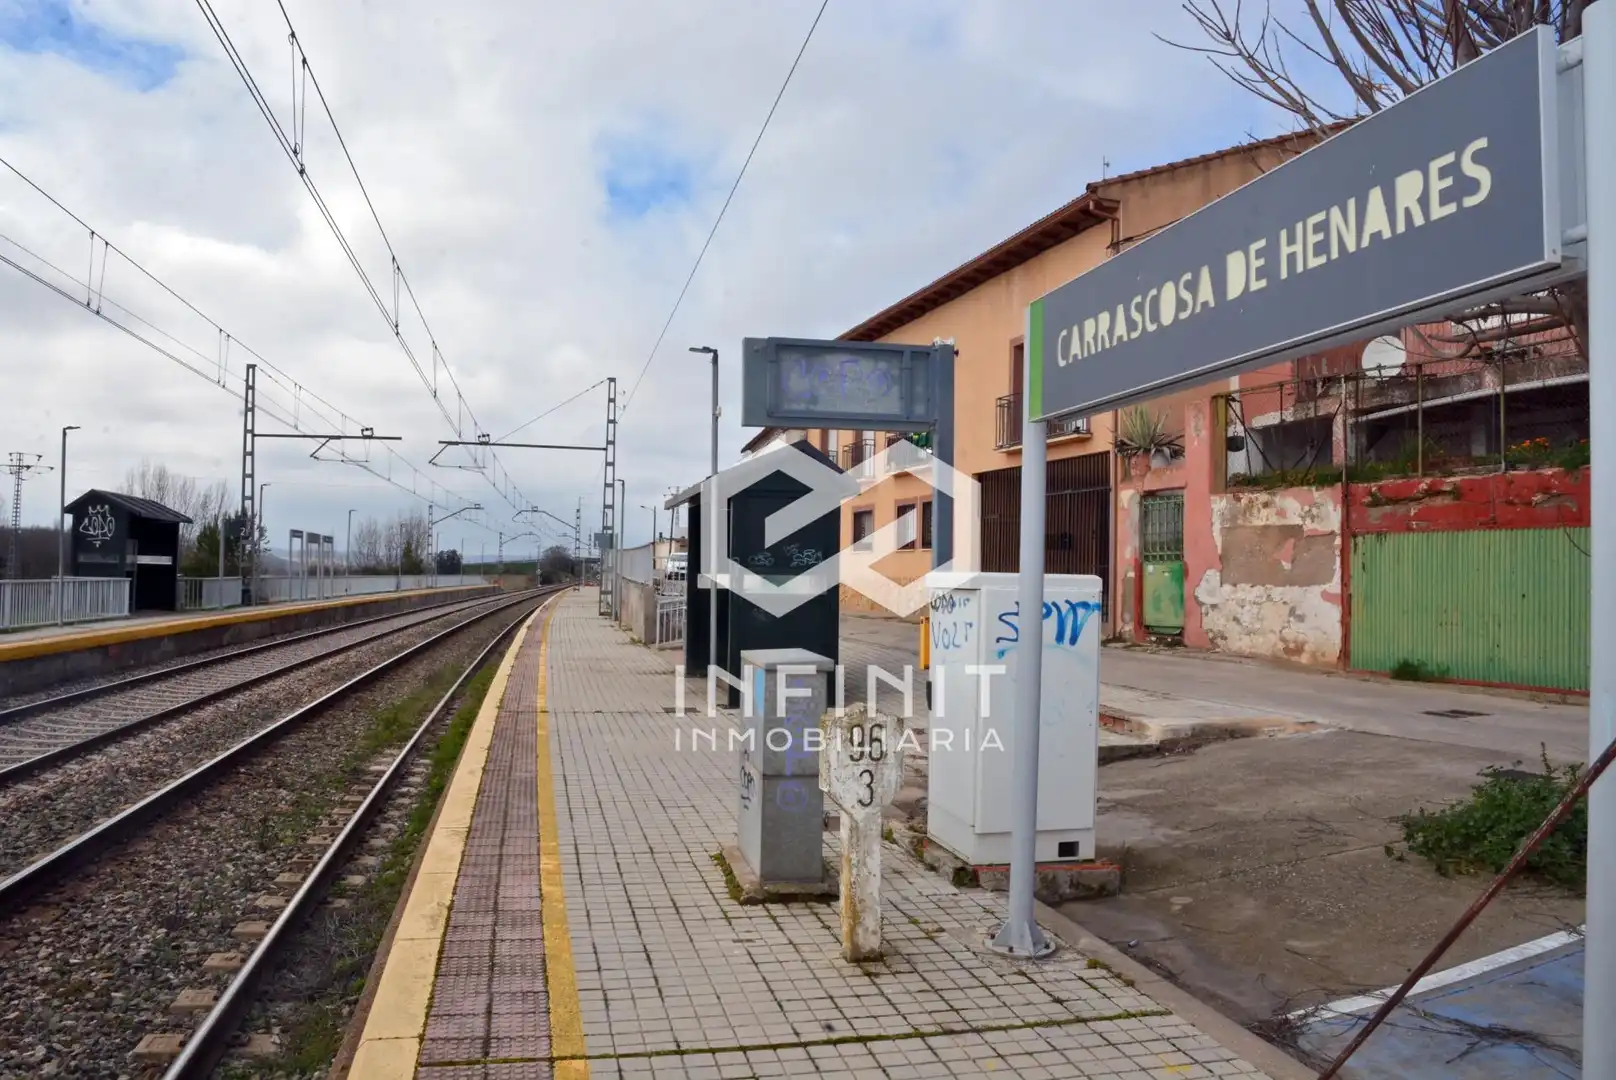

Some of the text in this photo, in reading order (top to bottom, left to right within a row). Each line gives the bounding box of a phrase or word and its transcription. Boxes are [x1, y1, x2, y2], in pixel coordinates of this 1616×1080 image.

[1057, 136, 1492, 367] CARRASCOSA DE HENARES
[849, 723, 885, 762] 96
[858, 769, 874, 807] 3
